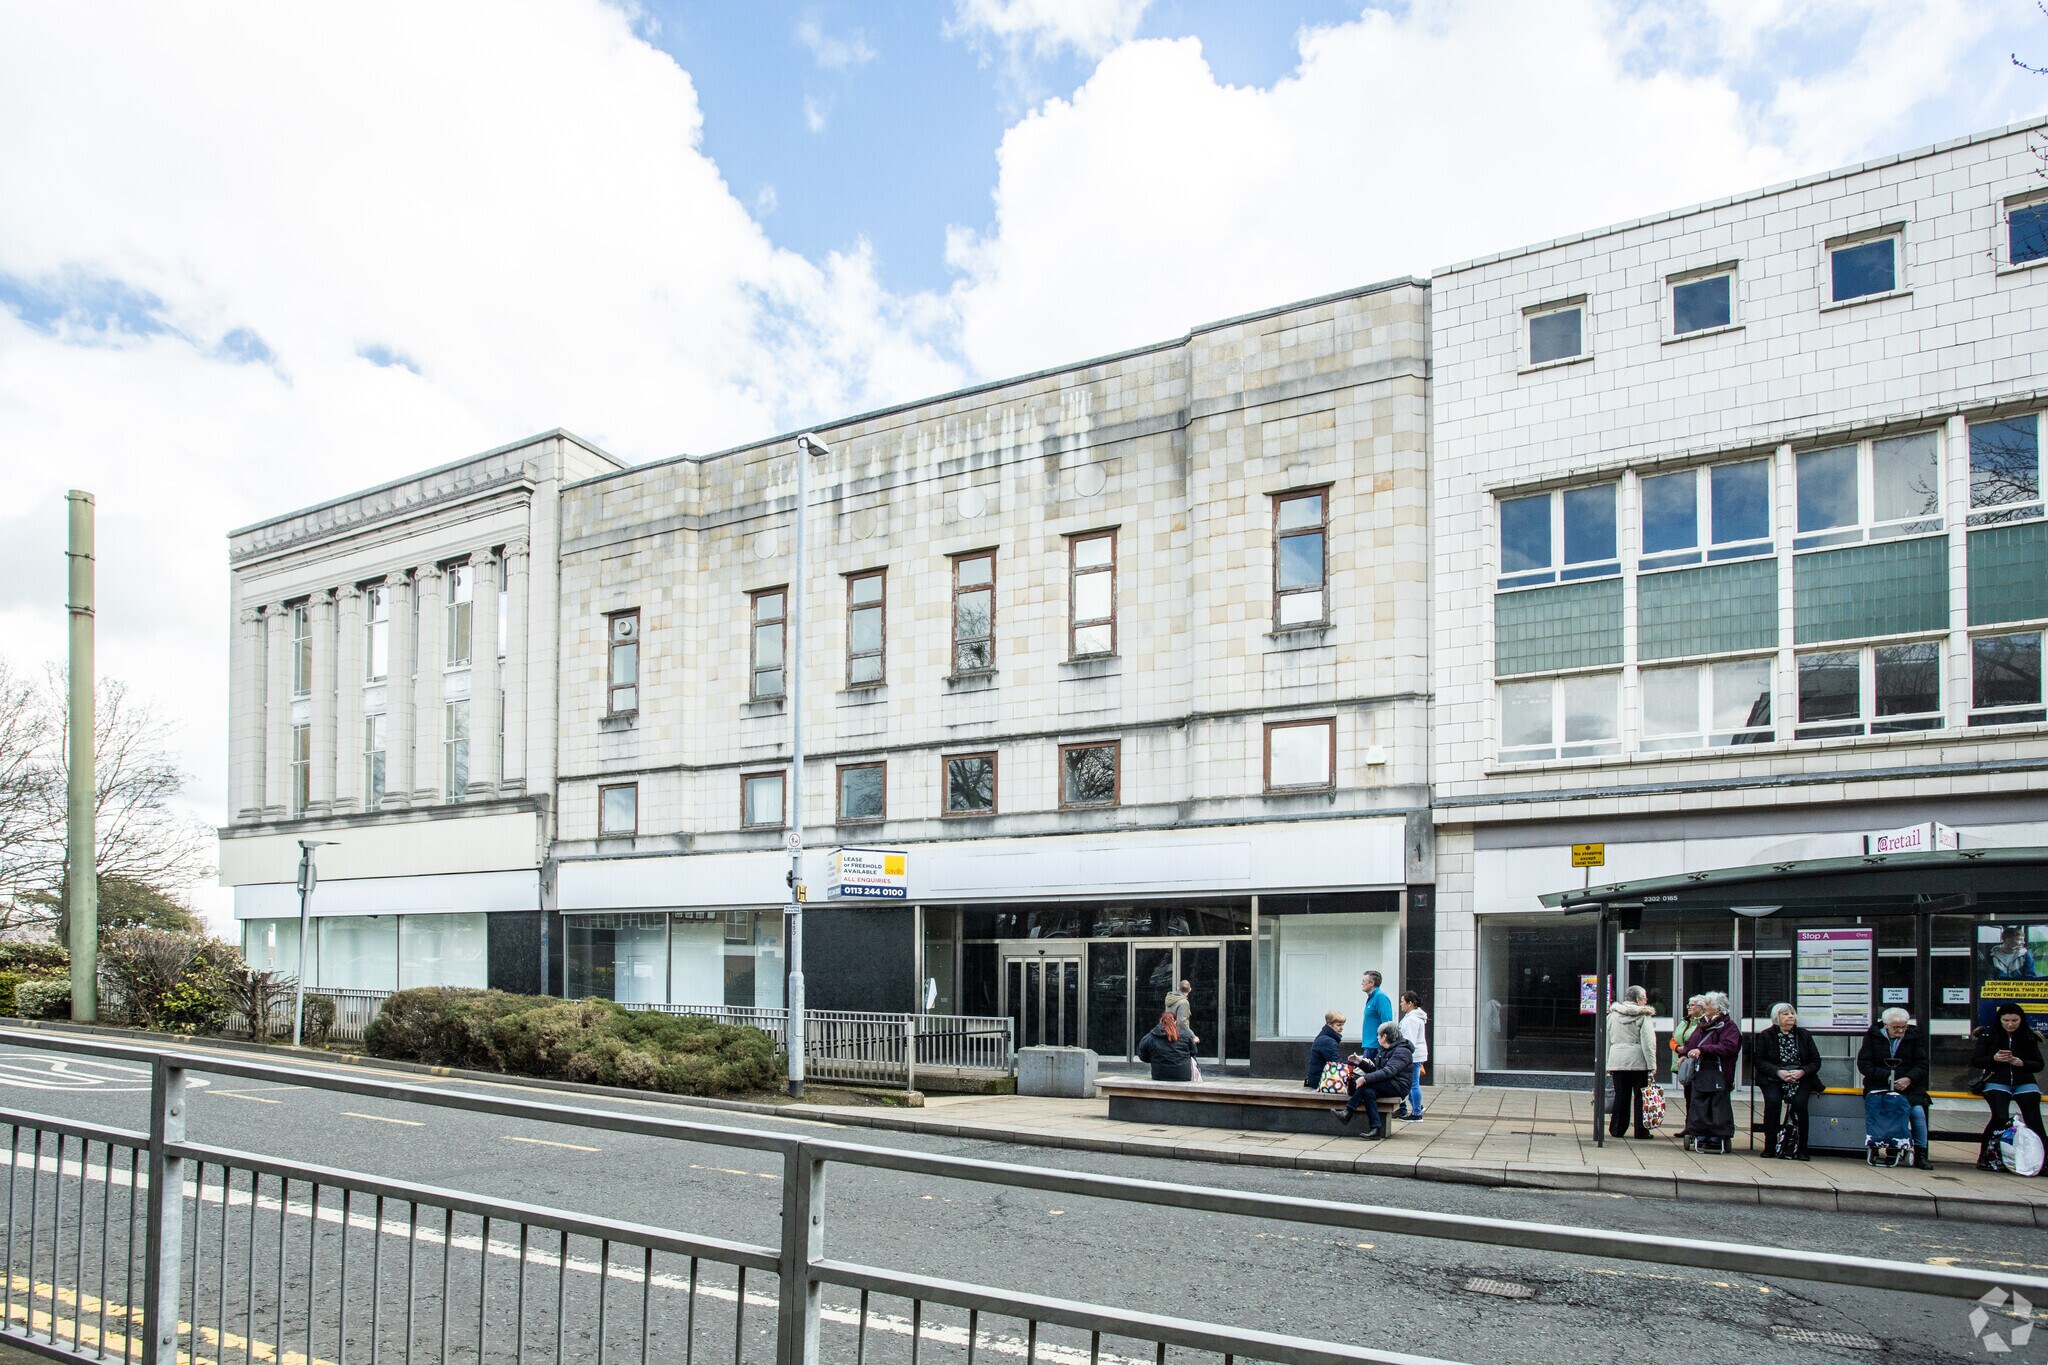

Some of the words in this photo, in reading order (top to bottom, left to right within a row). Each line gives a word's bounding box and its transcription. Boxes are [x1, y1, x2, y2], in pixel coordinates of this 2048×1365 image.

[1878, 829, 1921, 852] @retail
[844, 886, 863, 895] 0113
[864, 887, 881, 895] 244
[882, 888, 903, 896] 0100
[1802, 932, 1821, 940] Stop
